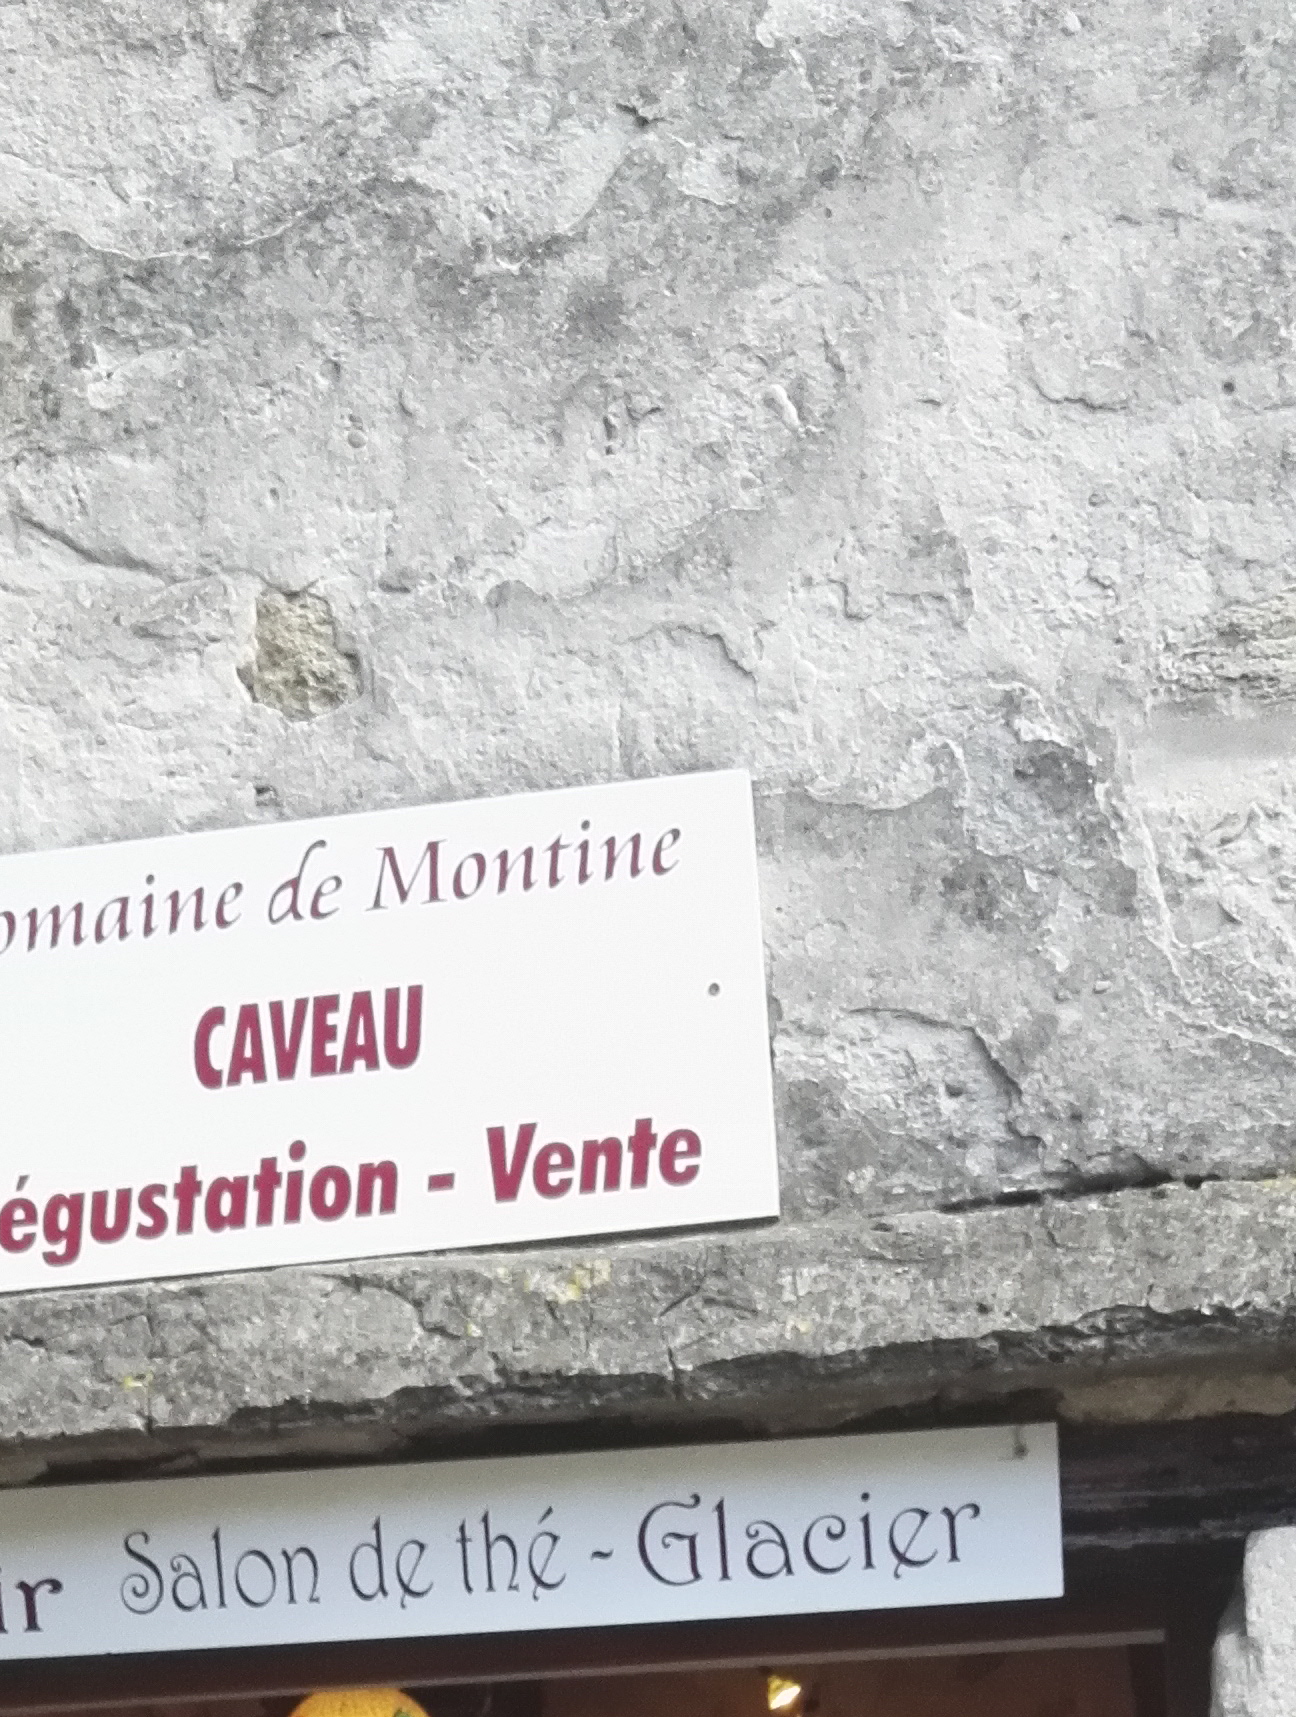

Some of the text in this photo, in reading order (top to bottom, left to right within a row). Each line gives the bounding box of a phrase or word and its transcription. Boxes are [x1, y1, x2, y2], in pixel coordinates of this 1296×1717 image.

[266, 839, 343, 924] de
[365, 819, 684, 913] Montine
[193, 983, 424, 1090] CAVEAU
[485, 1116, 703, 1204] Vente
[120, 1524, 322, 1615] Salon
[349, 1514, 435, 1610] de
[456, 1505, 568, 1602] thé
[636, 1490, 982, 1587] Glacier
